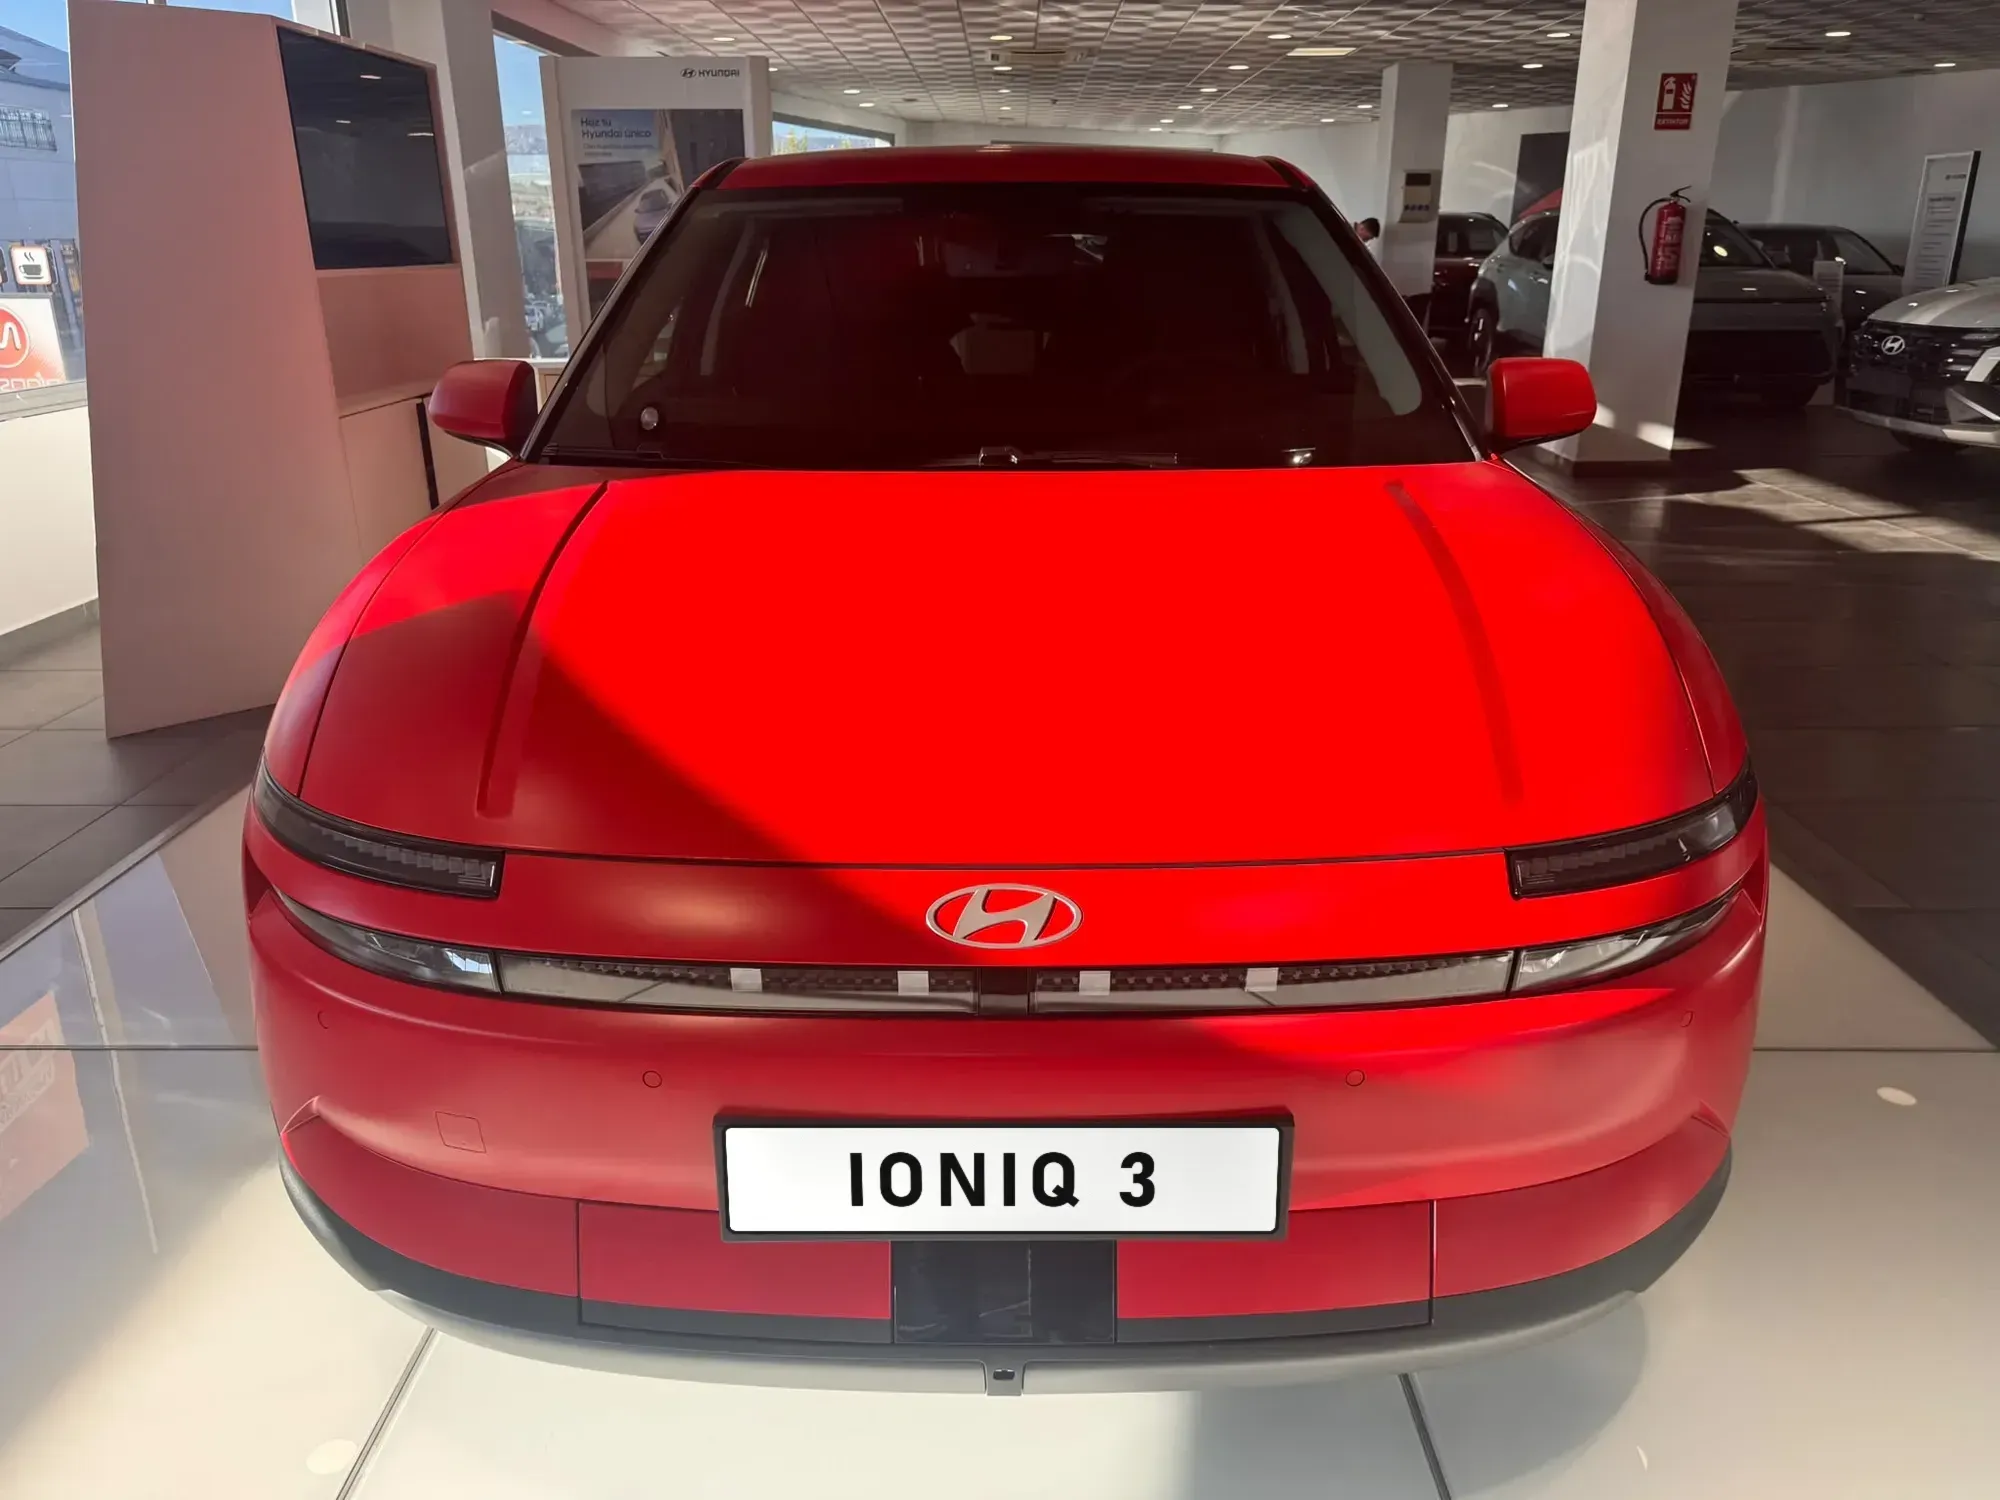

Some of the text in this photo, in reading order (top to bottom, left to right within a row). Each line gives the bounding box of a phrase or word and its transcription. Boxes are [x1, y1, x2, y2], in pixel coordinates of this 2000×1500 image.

[698, 69, 740, 77] HYUNDAI
[581, 117, 600, 126] Haz
[582, 129, 623, 139] Hyundai
[850, 1151, 1156, 1207] IONIQ 3
